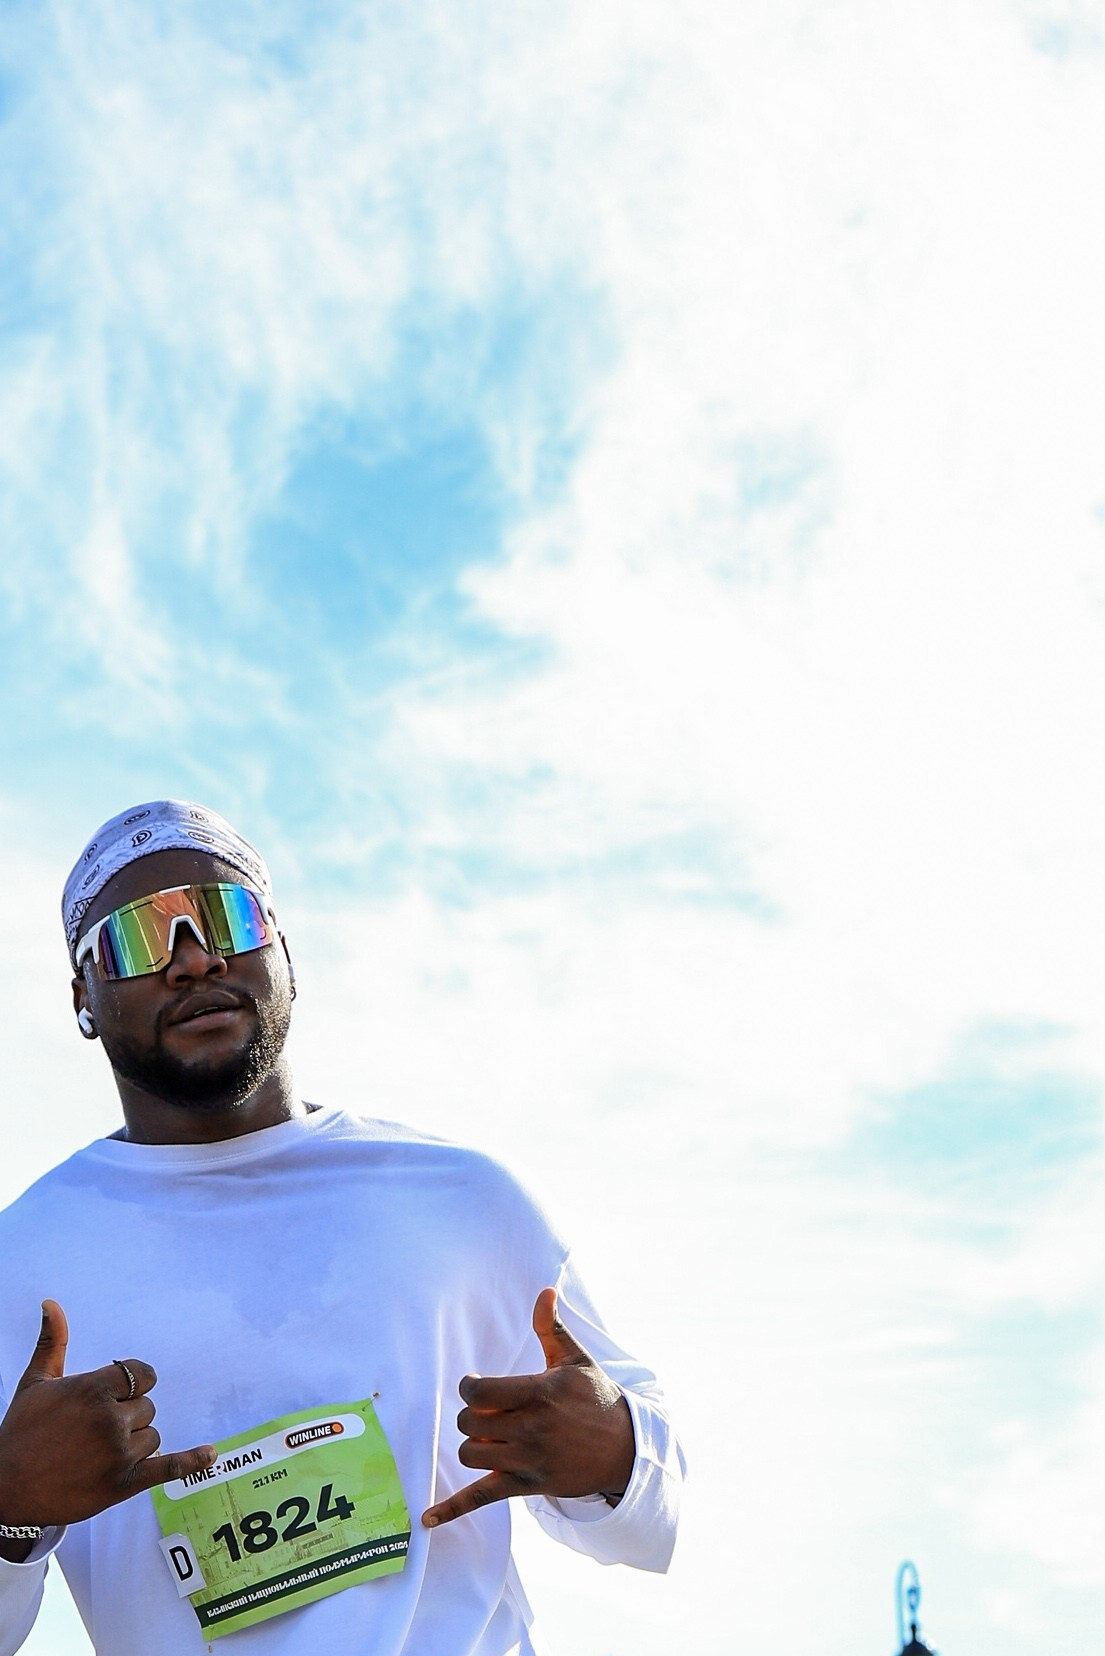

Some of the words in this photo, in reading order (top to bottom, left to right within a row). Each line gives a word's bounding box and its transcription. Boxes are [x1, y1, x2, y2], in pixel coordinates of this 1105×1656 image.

[289, 1425, 332, 1446] WINLINE
[212, 1483, 356, 1562] 1824
[169, 1545, 194, 1582] D
[319, 1545, 389, 1575] ПОЛУМАРАФОН
